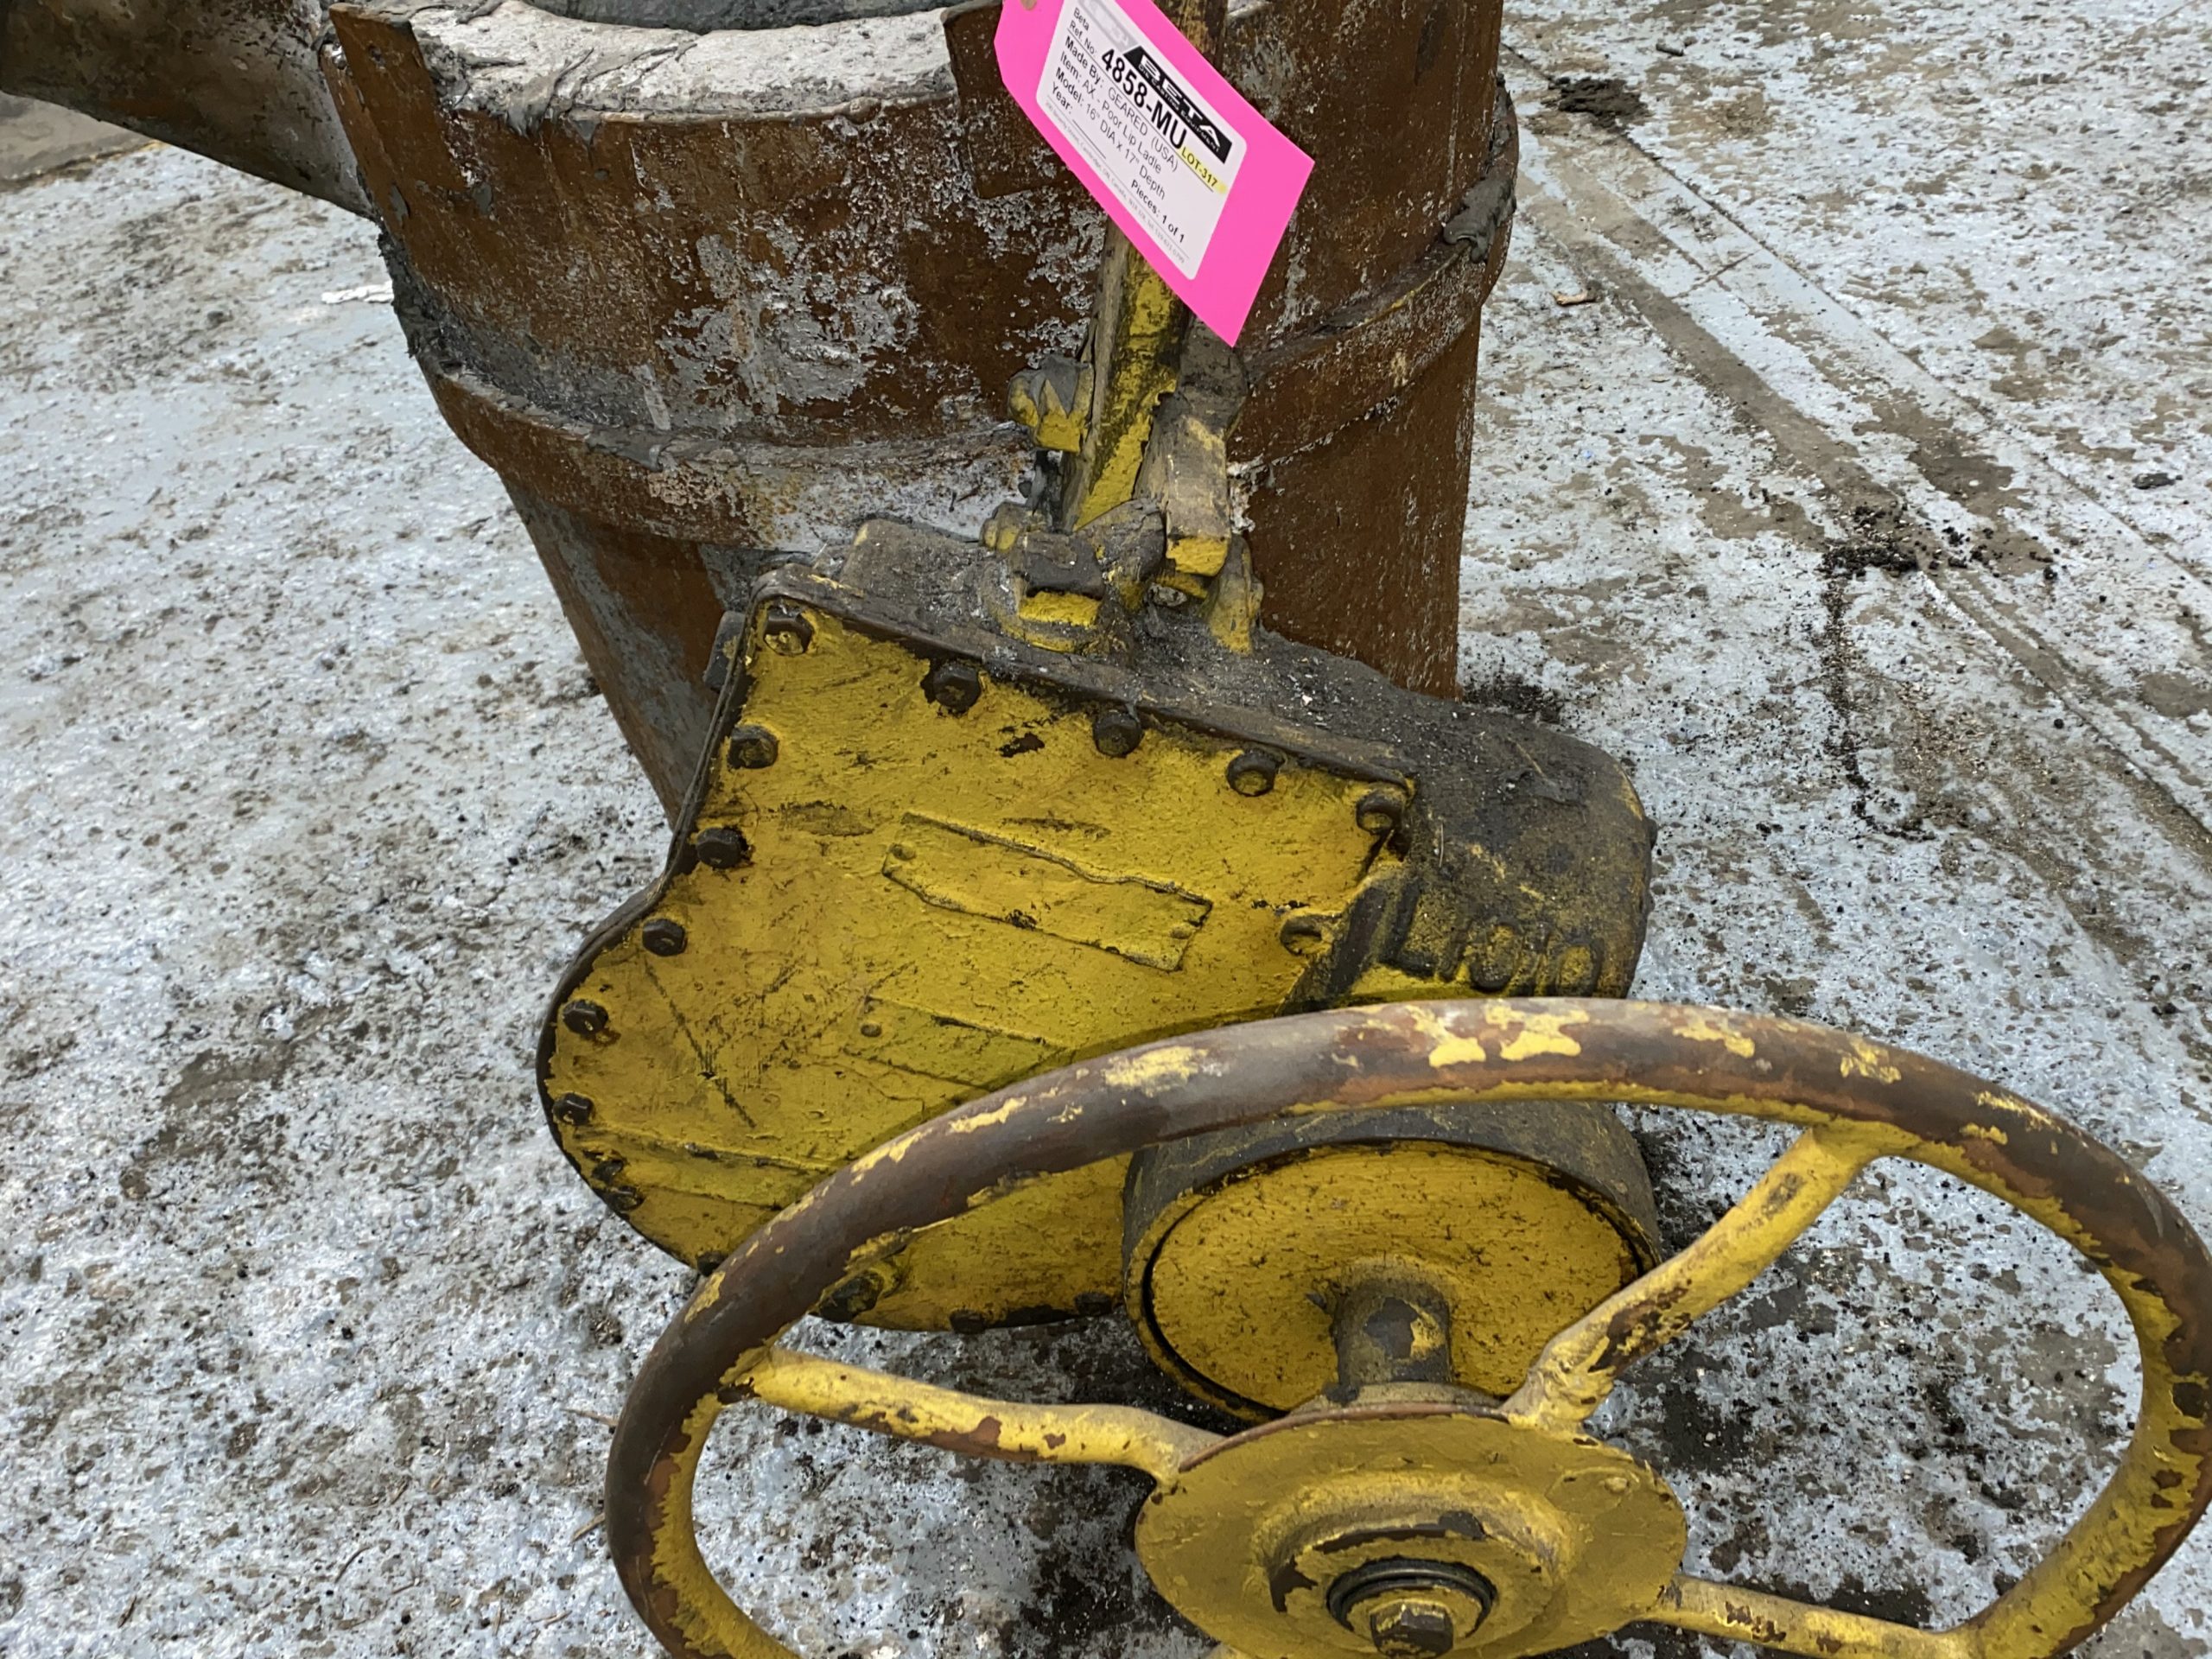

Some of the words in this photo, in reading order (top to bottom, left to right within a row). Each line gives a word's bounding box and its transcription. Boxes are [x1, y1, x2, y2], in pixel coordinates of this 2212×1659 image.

[1073, 6, 1090, 32] Beta
[1052, 81, 1073, 115] Year:
[1059, 50, 1082, 83] Item:
[1081, 79, 1096, 99] AX
[1101, 99, 1123, 130] Poor
[1122, 124, 1137, 146] Lip
[1137, 140, 1162, 175] Ladle
[1065, 35, 1089, 69] Made
[1089, 63, 1104, 88] By:
[1108, 86, 1148, 137] GEARED
[1150, 136, 1179, 173] (USA)
[1069, 19, 1084, 42] Ref.
[1084, 37, 1097, 55] No:
[1101, 48, 1188, 150] 4858-MU
[1140, 54, 1221, 149] BETA
[1055, 66, 1084, 107] Model:
[1099, 118, 1116, 145] DIA
[1116, 141, 1123, 151] x
[1139, 163, 1166, 200] Depth
[1181, 146, 1218, 188] LOT-317
[1130, 178, 1160, 218] Pieces:
[1162, 214, 1167, 225] 1
[1167, 223, 1179, 237] of
[1179, 233, 1185, 244] 1
